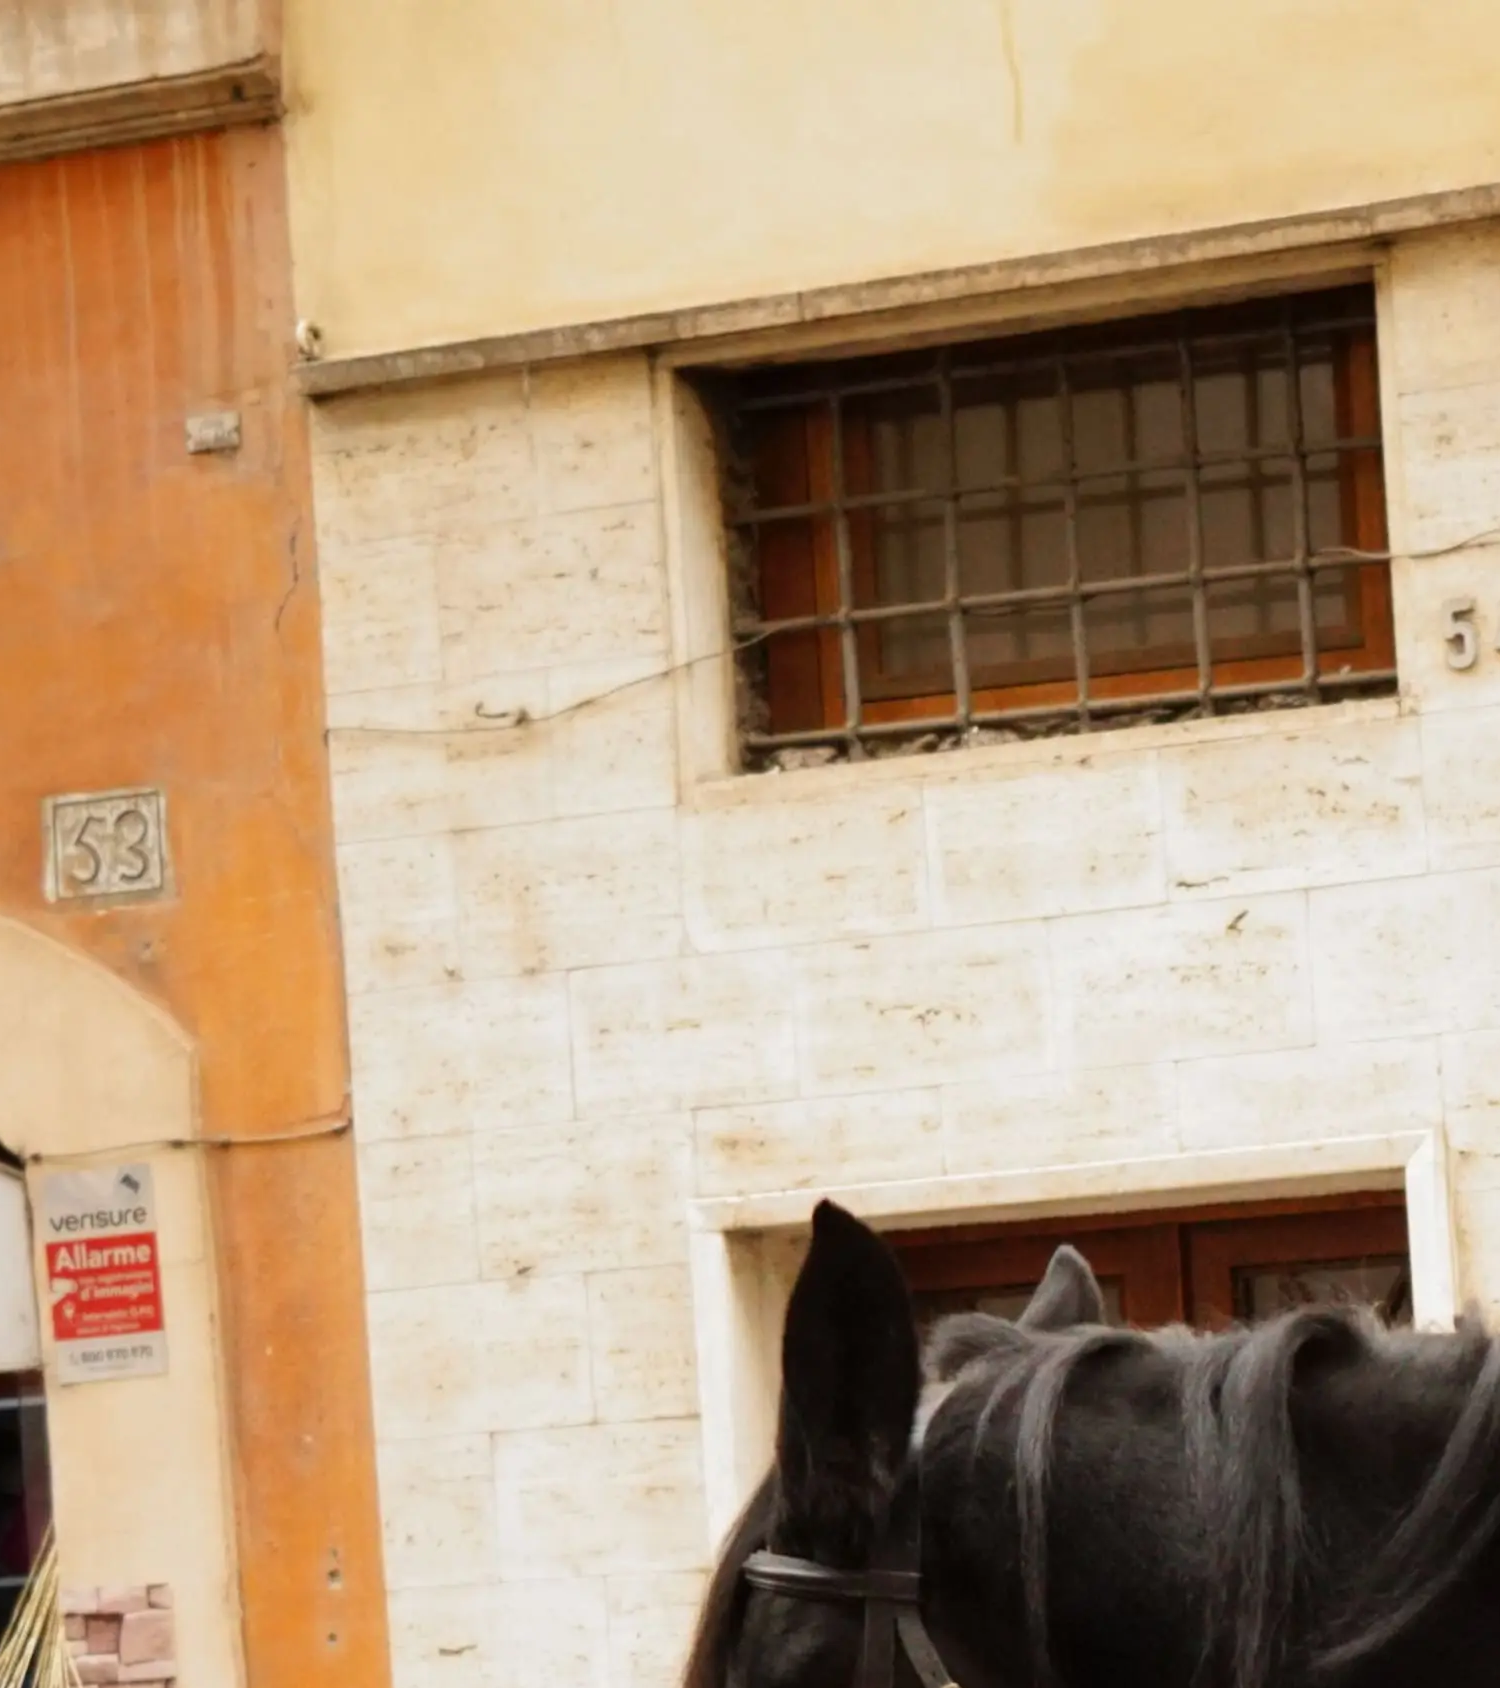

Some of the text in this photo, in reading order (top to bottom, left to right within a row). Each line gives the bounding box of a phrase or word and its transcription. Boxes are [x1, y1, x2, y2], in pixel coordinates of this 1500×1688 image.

[74, 808, 149, 885] 53
[49, 1205, 147, 1232] verisure
[54, 1242, 152, 1273] Allarme
